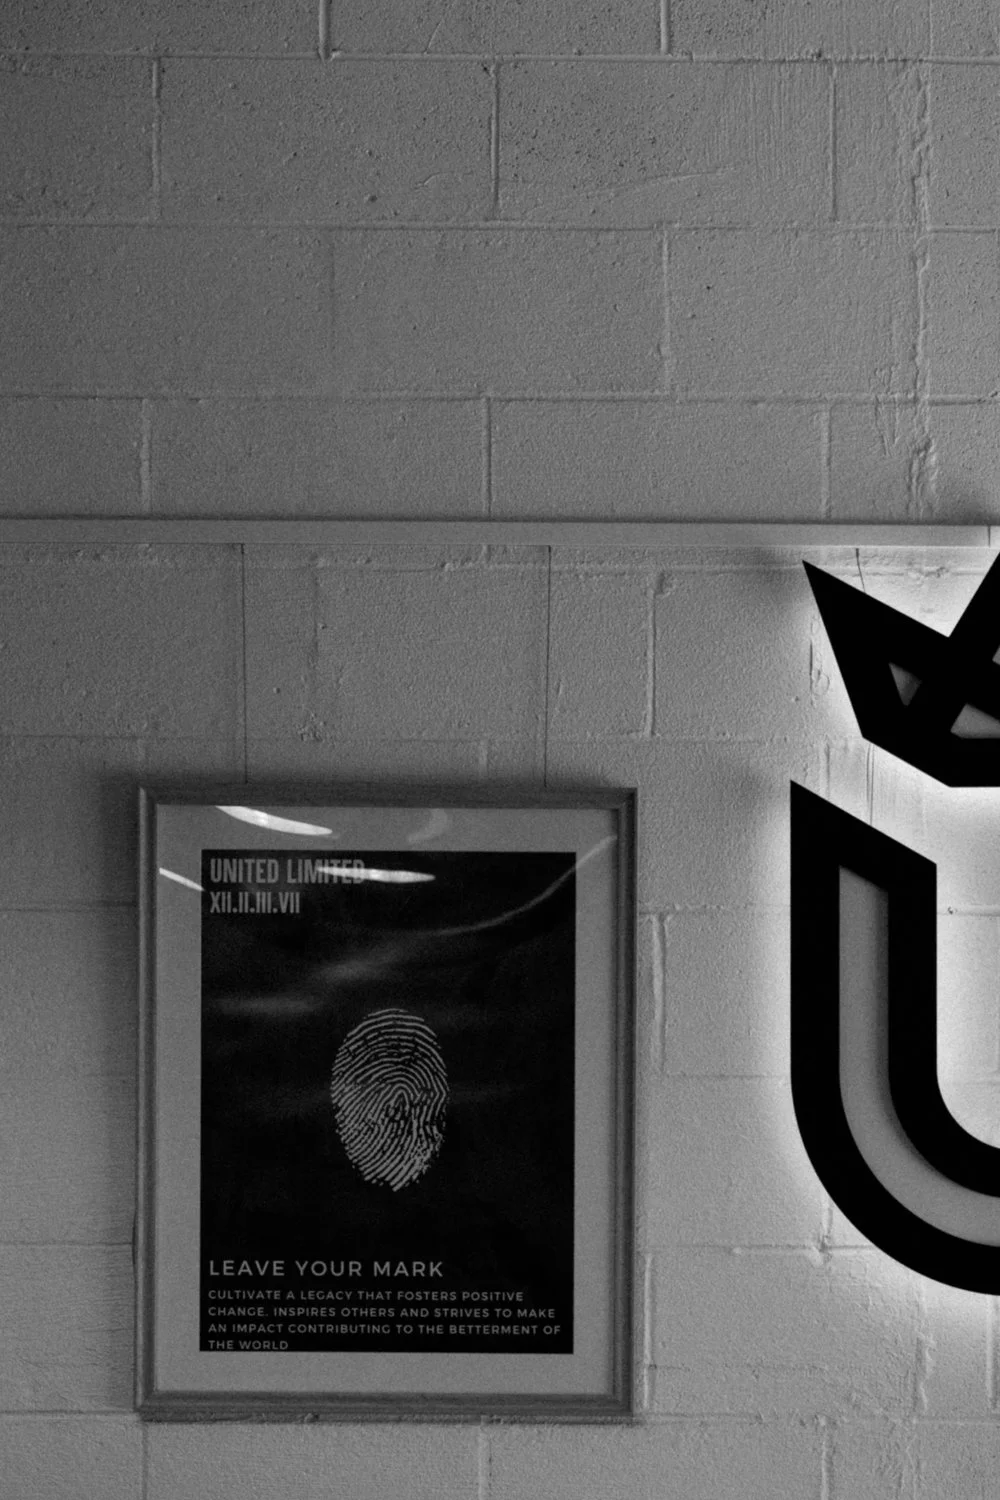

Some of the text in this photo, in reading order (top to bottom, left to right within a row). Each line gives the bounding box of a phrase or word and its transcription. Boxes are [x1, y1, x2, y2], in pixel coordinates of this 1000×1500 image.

[209, 857, 366, 885] UNITED LIMITED
[208, 1259, 444, 1278] LEAVE YOUR MARK
[207, 1289, 524, 1302] CULTIVATE A LEGACY THAT FOSTERS POSITIVE
[273, 1307, 337, 1318] INSPIRES
[340, 1307, 396, 1318] OTHERS
[399, 1307, 430, 1318] AND
[433, 1307, 491, 1319] STRIVES
[494, 1308, 513, 1319] TO
[516, 1308, 556, 1319] MAKE
[207, 1323, 561, 1336] AN IMPACT CONTRIBUTING TO THE BETTERMENT OF
[207, 1340, 289, 1350] THE WORLD
